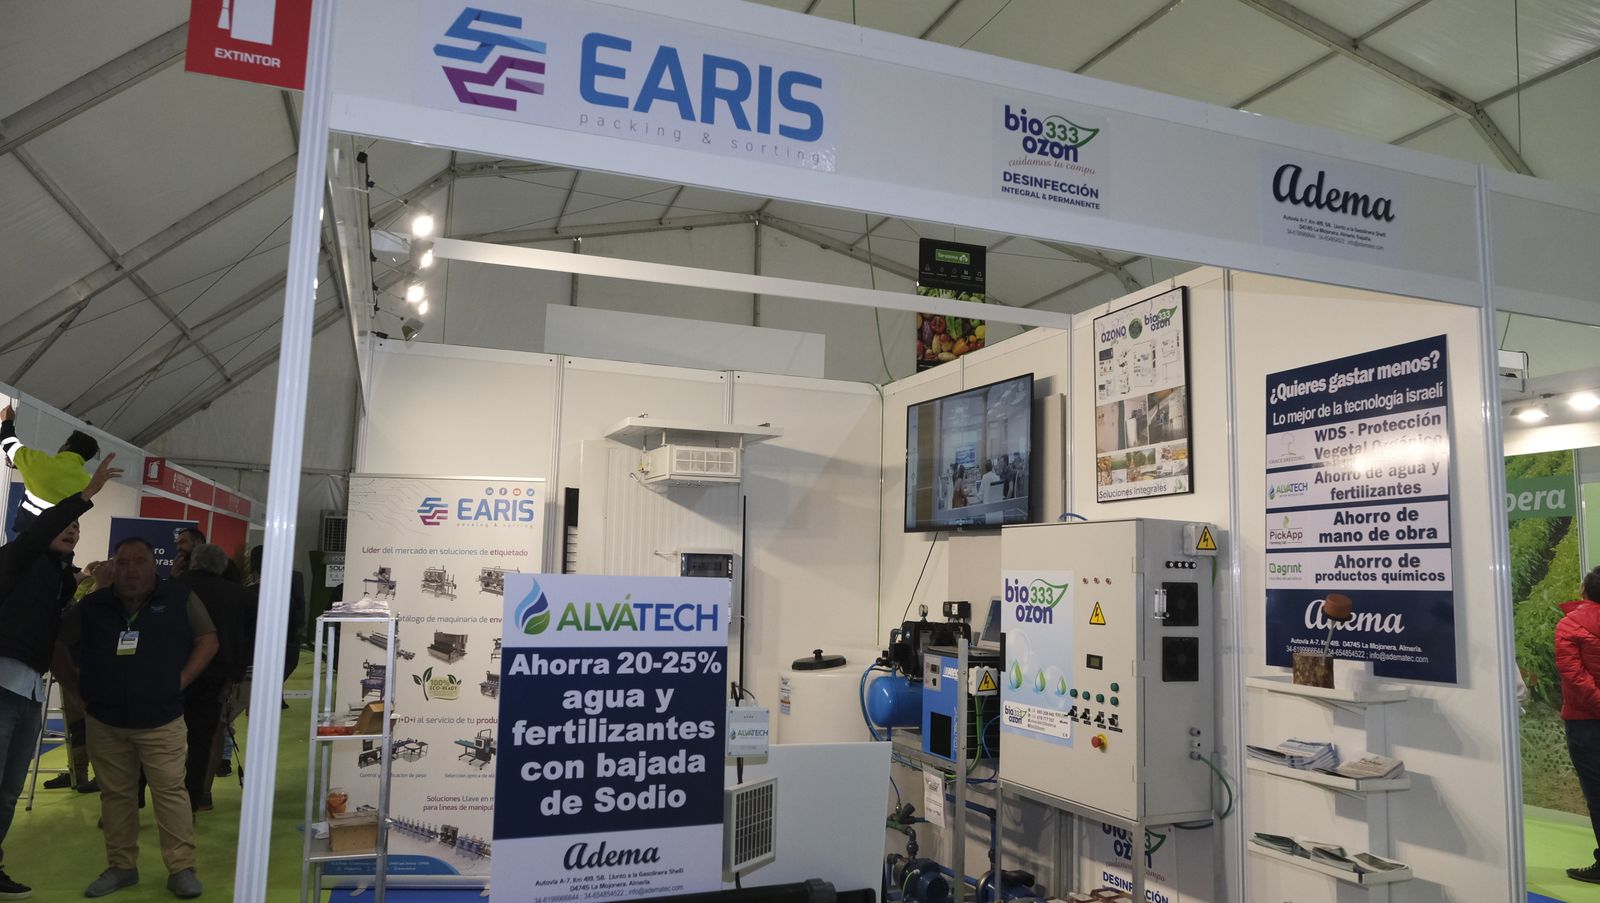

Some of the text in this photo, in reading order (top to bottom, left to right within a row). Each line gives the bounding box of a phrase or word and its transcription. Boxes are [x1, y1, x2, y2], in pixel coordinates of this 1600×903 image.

[214, 46, 281, 69] EXTINTOR
[578, 31, 825, 143] EARIS
[1004, 104, 1079, 144] bio 333
[580, 112, 820, 164] packing & sorting
[1022, 135, 1078, 163] ozon
[1008, 155, 1052, 168] cuidamos
[1003, 171, 1099, 199] DESINFECCIÓN
[1272, 163, 1395, 222] Adema
[1001, 186, 1041, 199] INTEGRAL
[1048, 194, 1101, 210] PERMANENTE
[1100, 325, 1127, 344] OZONO
[1150, 318, 1171, 331] ozon
[1269, 350, 1441, 404] ¿Quieres gastar menos?
[1272, 381, 1444, 426] Lo mejor de la tecnología israelí
[1314, 426, 1347, 443] WDS
[1358, 412, 1442, 436] Protección
[1314, 440, 1368, 460] Vegetal
[1314, 461, 1441, 485] Ahorro de agua y
[1098, 485, 1134, 500] Soluciones
[1330, 481, 1422, 501] fertilizantes
[457, 498, 535, 522] EARIS
[1333, 507, 1419, 526] Ahorro de
[1269, 530, 1303, 541] PickApp
[1319, 525, 1437, 543] mano de obra
[382, 546, 394, 555] del
[395, 546, 427, 555] mercado
[439, 548, 478, 556] soluciones
[480, 548, 489, 556] de
[490, 548, 528, 558] etiquetado
[1334, 553, 1420, 568] Ahorro de
[1276, 563, 1302, 576] agrint
[1315, 569, 1446, 584] productos químicos
[1005, 578, 1054, 605] bio 333
[397, 615, 425, 625] atálogo
[426, 615, 436, 623] de
[437, 615, 478, 625] maquinaria
[556, 593, 719, 633] ALVÁTECH
[1015, 604, 1053, 624] ozon
[508, 651, 722, 676] Ahorra 20-25%
[561, 687, 675, 715] agua y
[425, 716, 455, 724] servicio
[456, 716, 466, 724] de
[476, 717, 498, 726] produ
[512, 716, 716, 746] fertilizantes
[520, 749, 706, 783] con bajada
[423, 804, 438, 812] para
[468, 804, 494, 812] manipul
[540, 784, 687, 816] de Sodio
[563, 841, 661, 871] Adema
